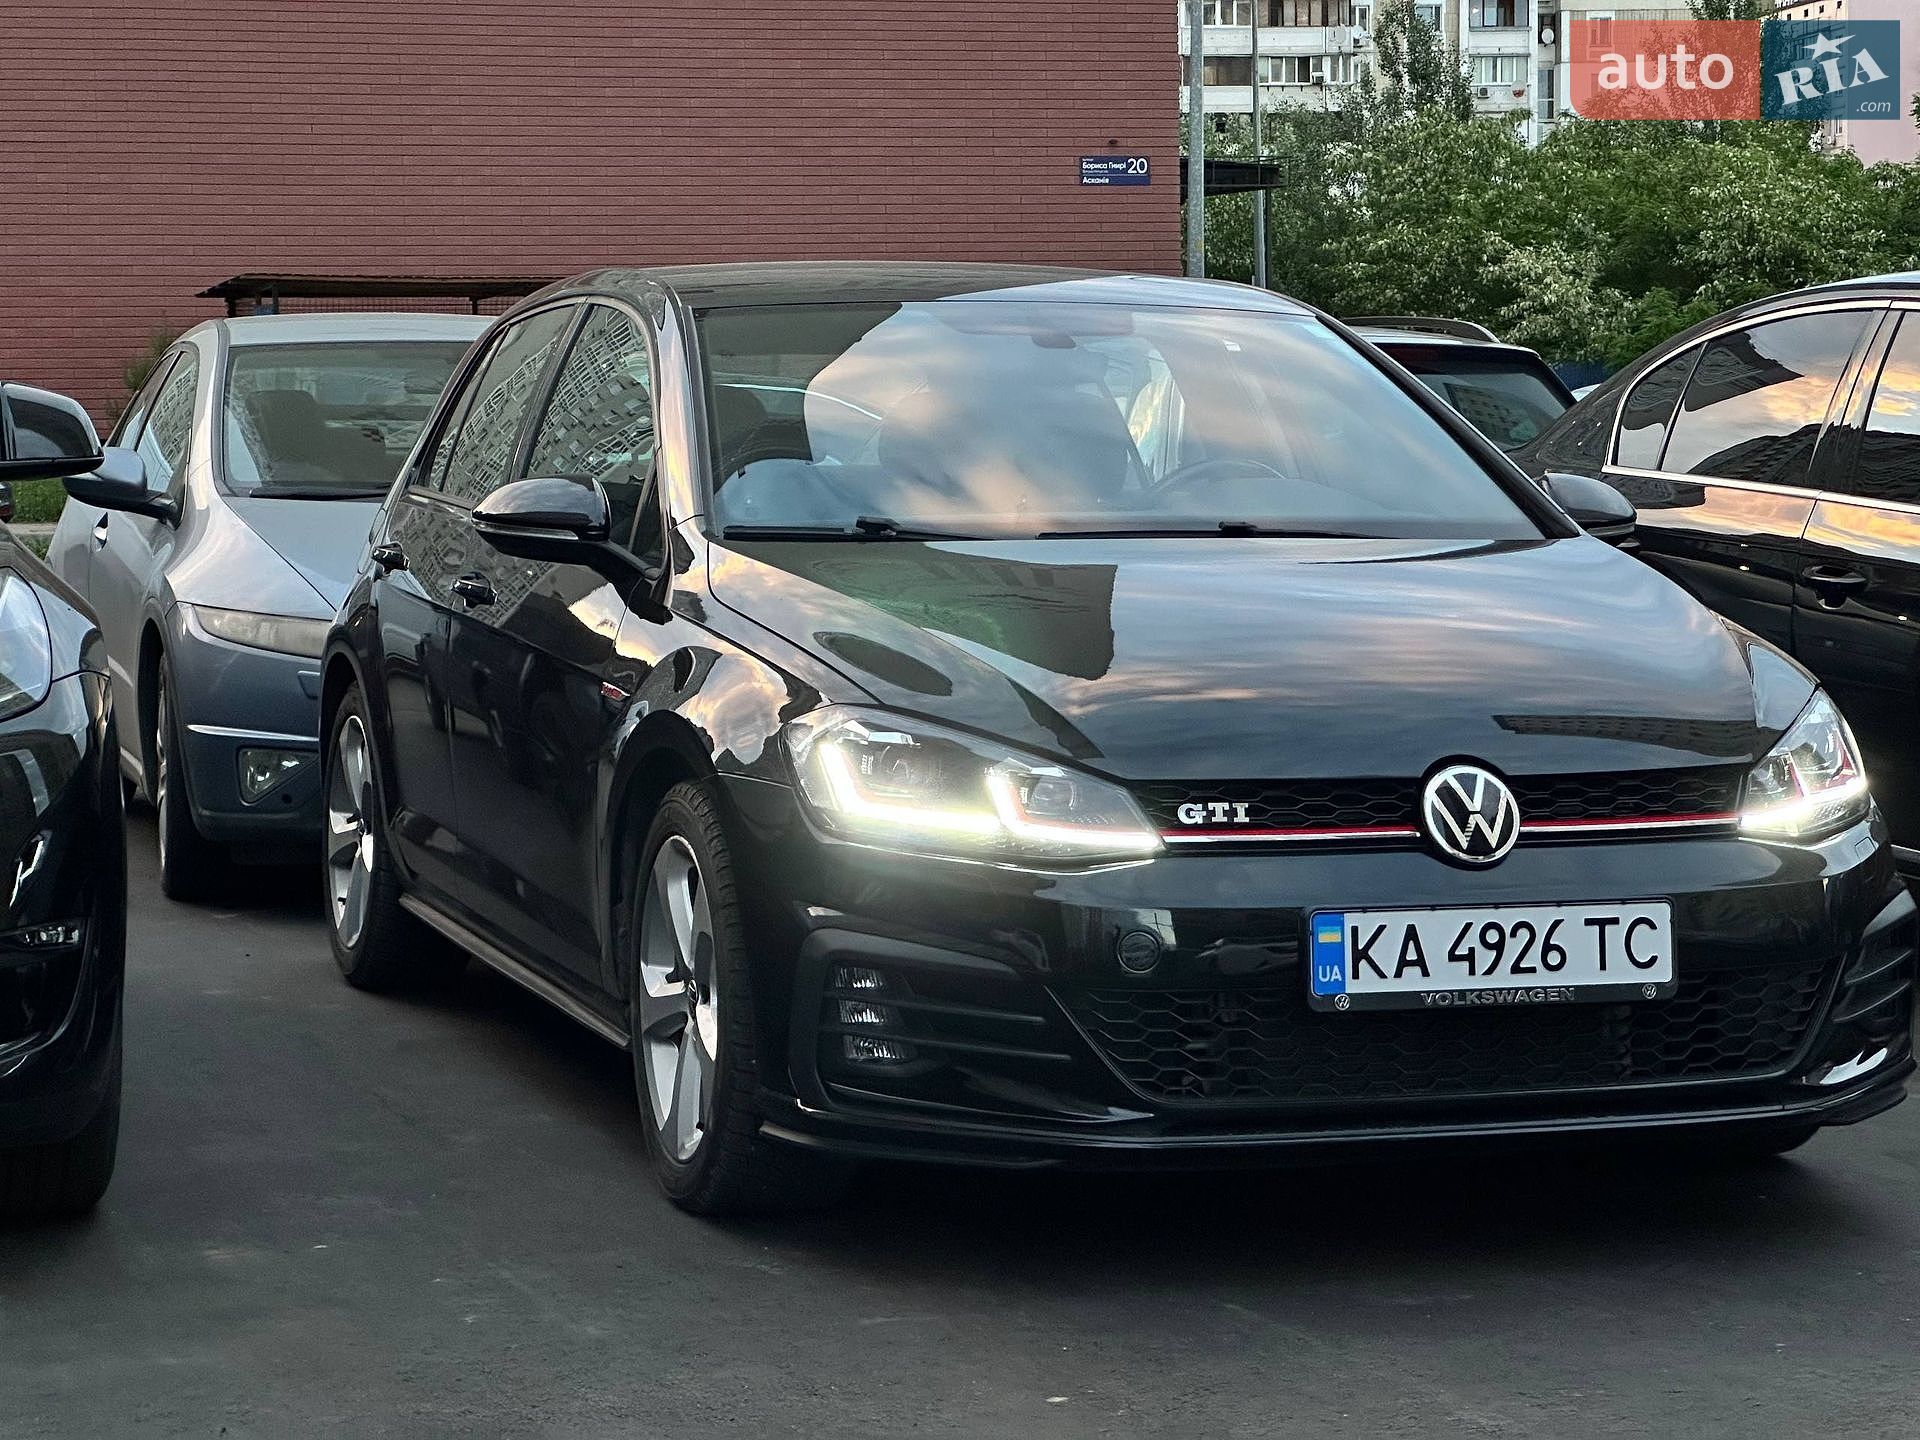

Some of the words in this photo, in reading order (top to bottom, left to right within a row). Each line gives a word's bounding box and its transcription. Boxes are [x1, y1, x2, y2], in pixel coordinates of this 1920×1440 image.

[1127, 158, 1148, 174] 20
[1177, 802, 1250, 825] GTI
[1350, 923, 1431, 980] KA
[1447, 918, 1568, 976] 4926
[1583, 916, 1659, 972] TC
[1318, 964, 1342, 983] UA
[1420, 987, 1576, 1008] VOLKSWAGEN
